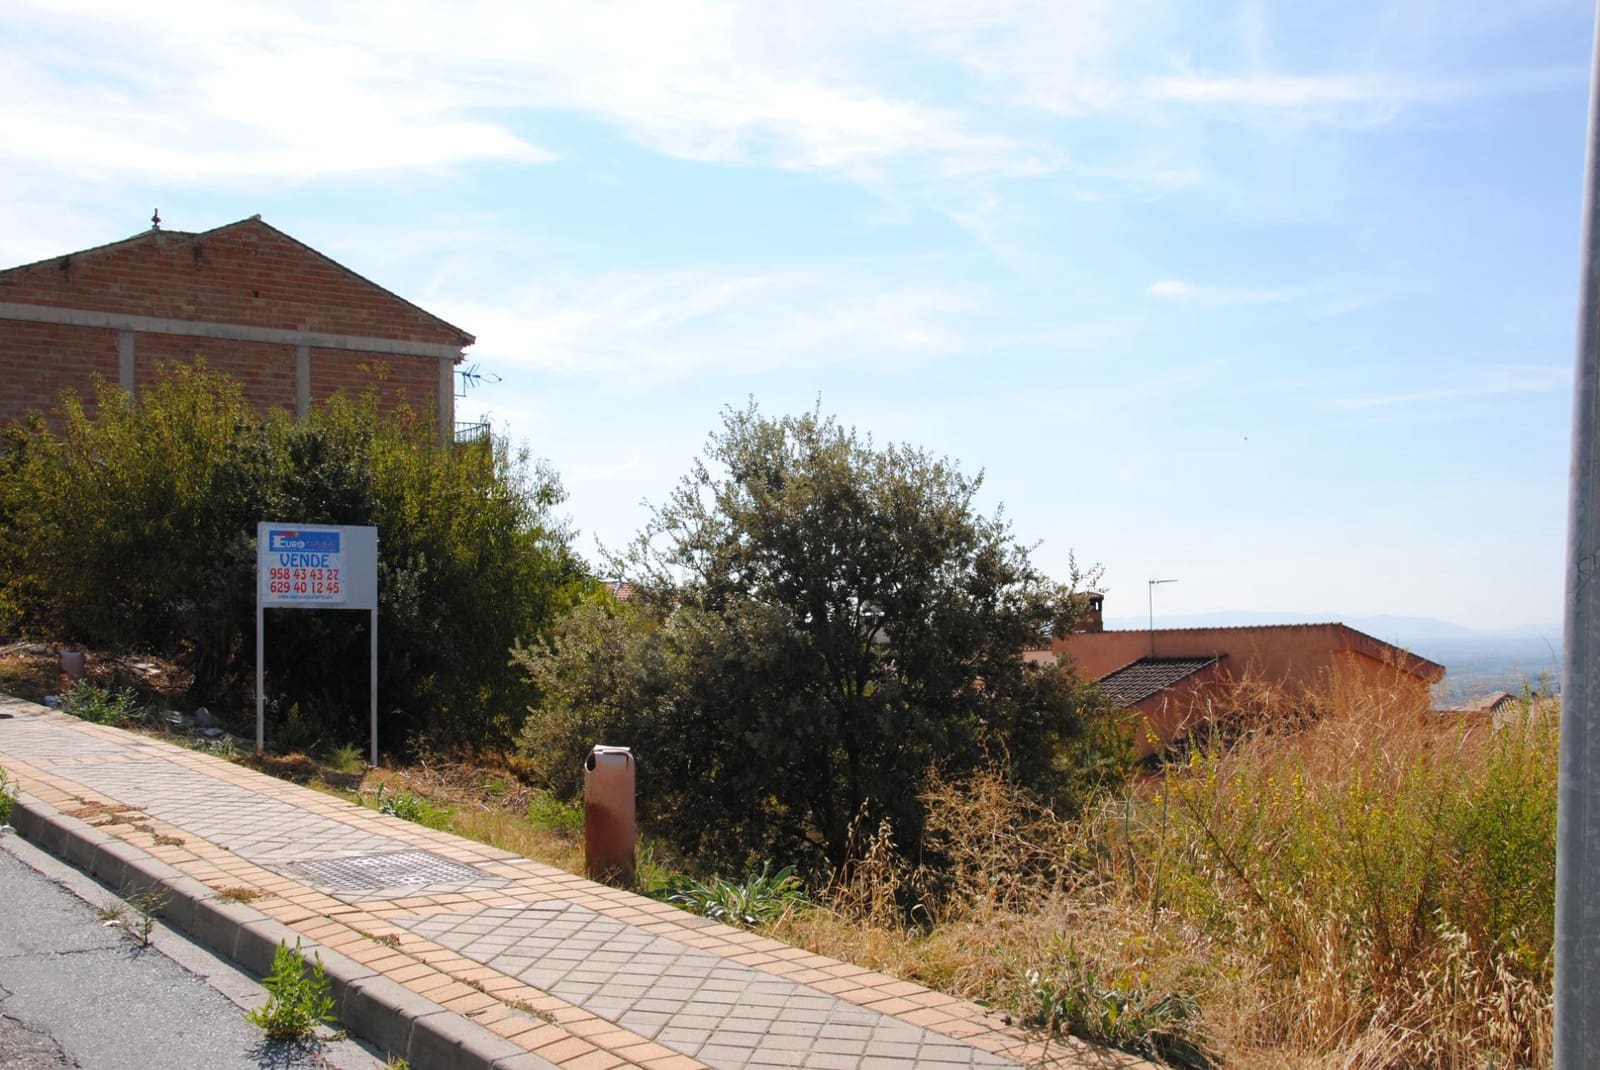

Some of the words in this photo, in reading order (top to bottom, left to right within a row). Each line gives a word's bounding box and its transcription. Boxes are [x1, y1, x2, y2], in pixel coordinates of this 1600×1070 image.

[280, 553, 330, 568] VENDE
[270, 568, 290, 580] 958
[293, 568, 307, 580] 43
[310, 568, 323, 580] 43
[326, 569, 339, 580] 27
[270, 581, 290, 593] 629
[293, 582, 307, 593] 40
[311, 582, 323, 593] 12
[326, 582, 340, 594] 45
